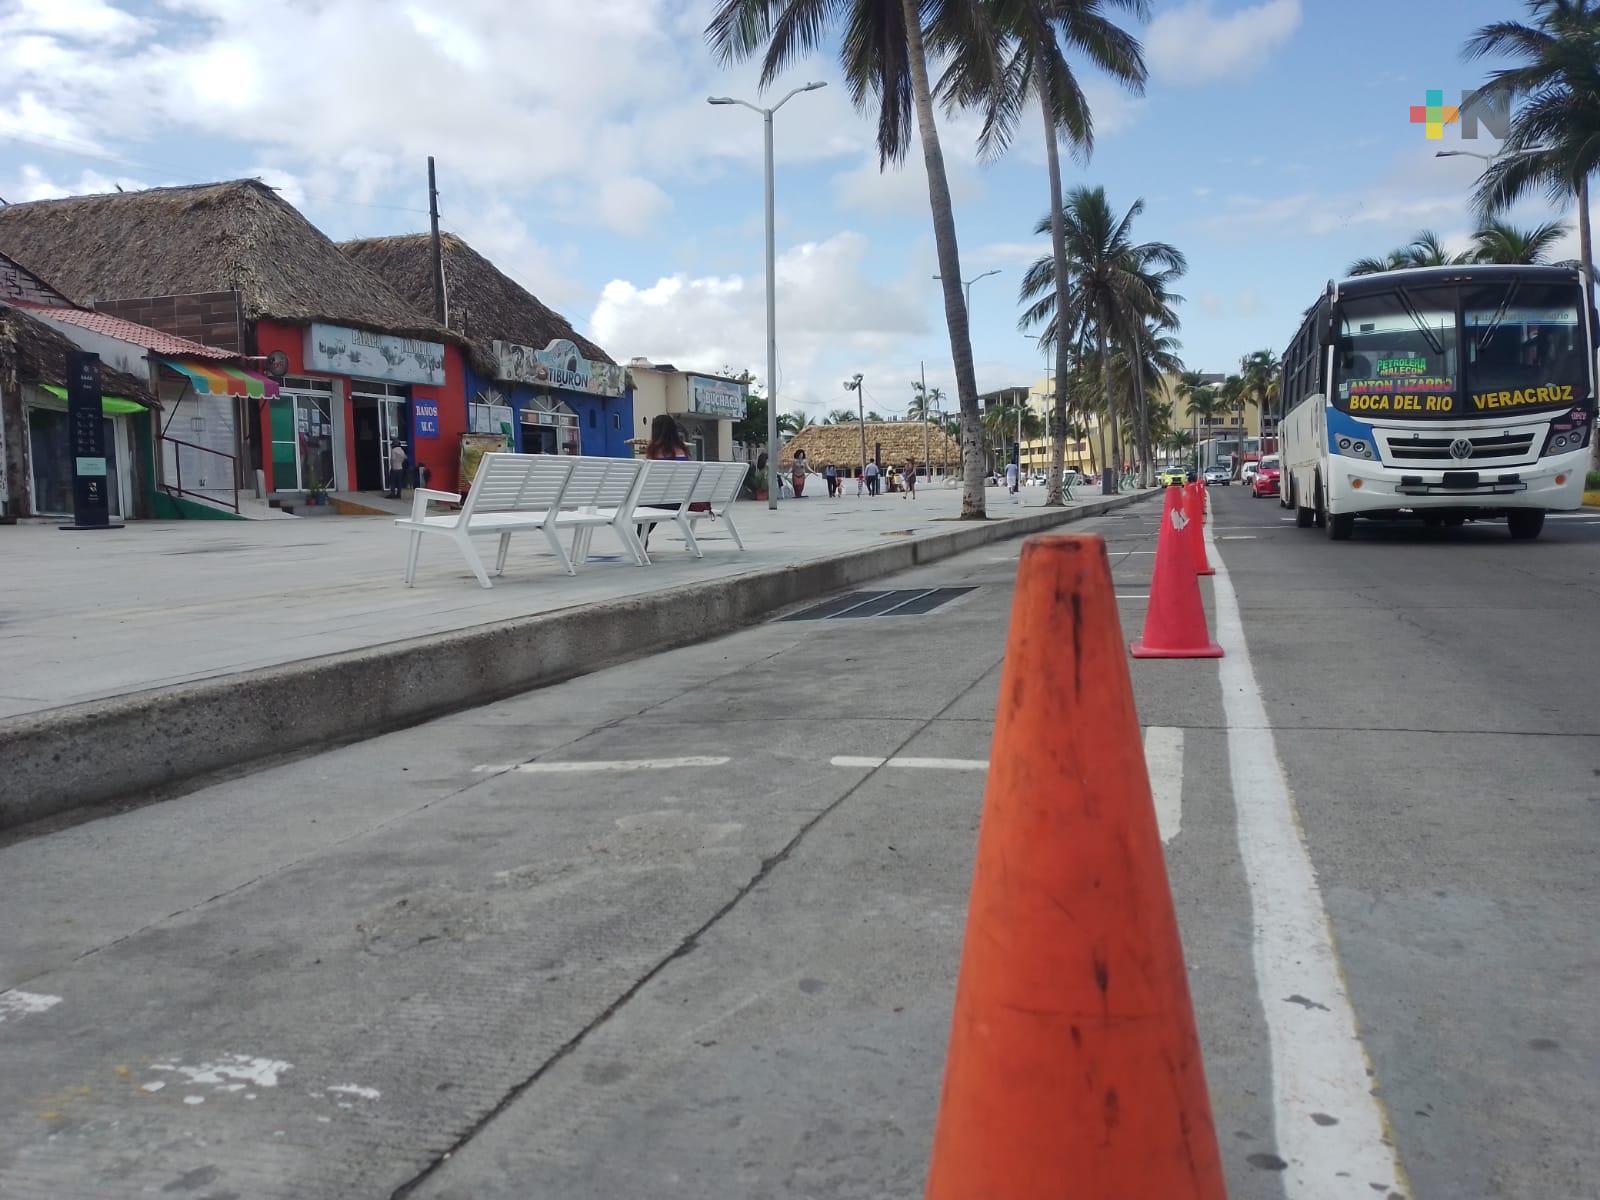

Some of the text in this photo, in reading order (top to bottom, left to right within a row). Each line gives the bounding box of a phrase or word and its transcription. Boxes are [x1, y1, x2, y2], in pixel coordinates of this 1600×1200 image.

[1377, 358, 1427, 371] PETROLERA
[1380, 366, 1423, 377] MALECON
[549, 367, 588, 388] TIBURON
[1351, 377, 1454, 394] ANTON LIZARDO
[1349, 395, 1453, 411] BOCA DEL RIO
[1472, 385, 1574, 409] VERACRUZ
